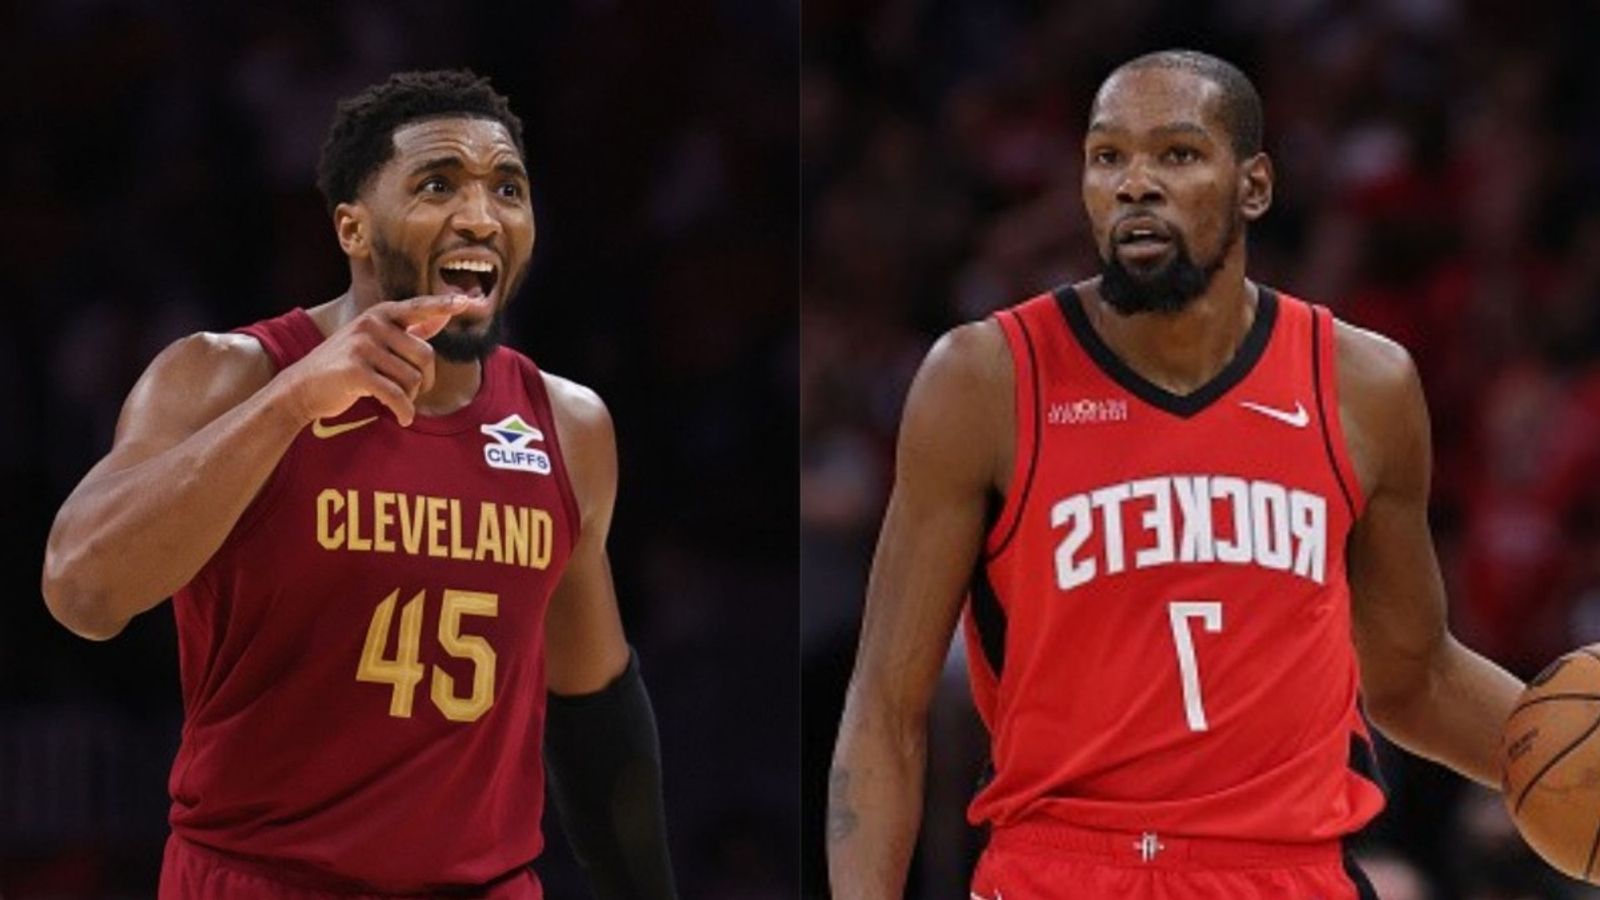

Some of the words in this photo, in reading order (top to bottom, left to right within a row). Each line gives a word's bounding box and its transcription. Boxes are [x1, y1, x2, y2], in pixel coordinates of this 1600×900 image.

[487, 448, 548, 470] CLIFFS
[316, 488, 553, 570] CLEVELAND
[355, 586, 499, 722] 45
